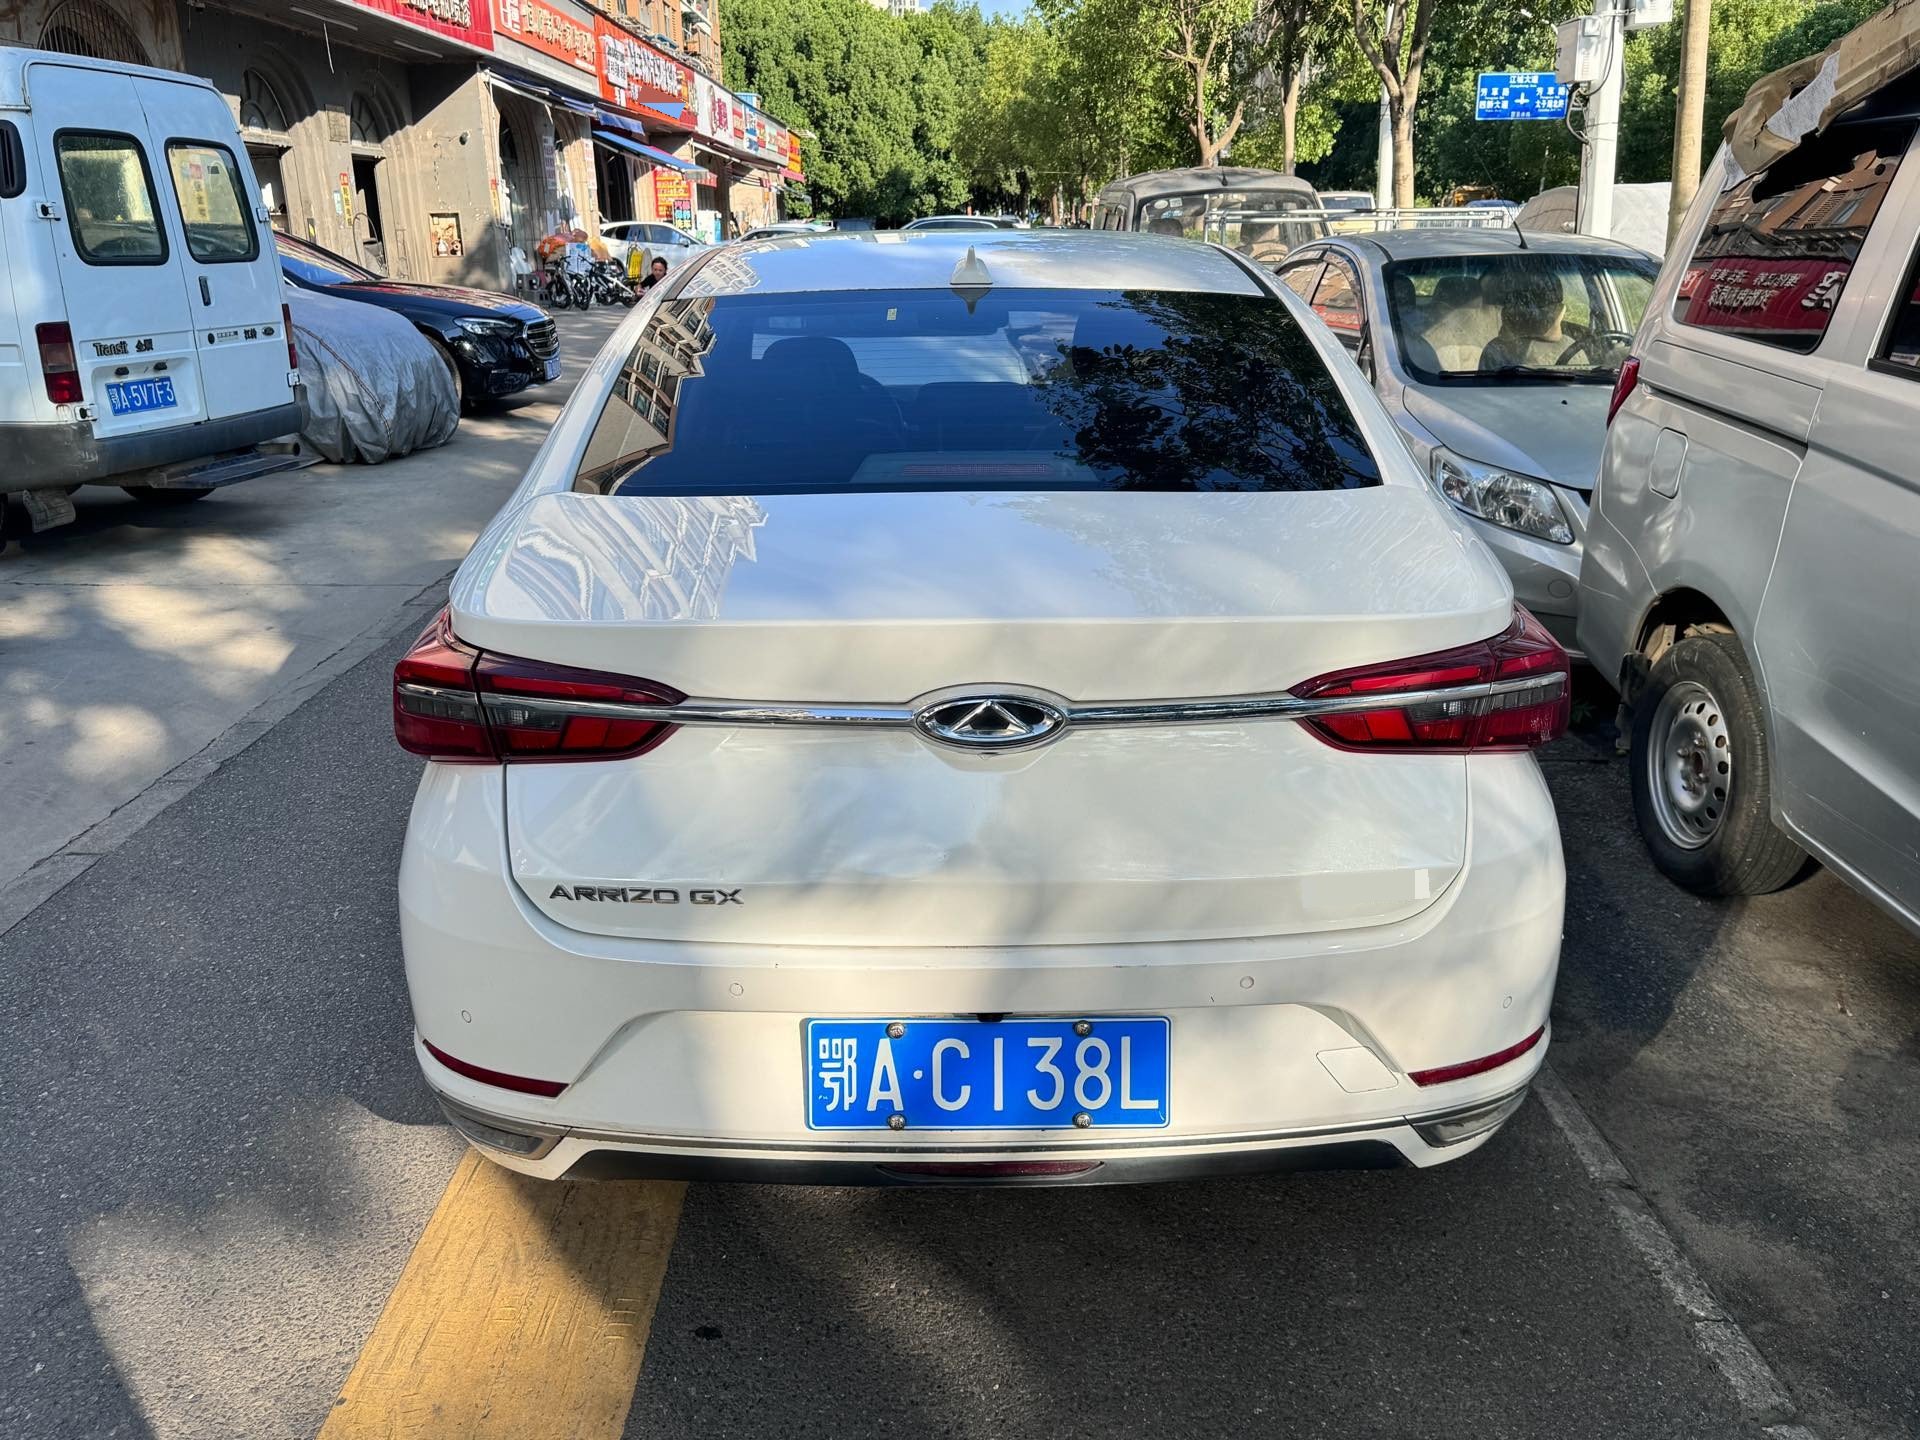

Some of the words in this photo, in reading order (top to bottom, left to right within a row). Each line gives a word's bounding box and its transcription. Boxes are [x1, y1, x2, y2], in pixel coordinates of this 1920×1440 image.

[93, 341, 129, 356] Transit
[109, 381, 174, 409] 鄂A·5V7F3
[550, 884, 680, 904] ARRIZO
[689, 889, 745, 905] GX
[819, 1036, 1159, 1111] 鄂A·C138L
